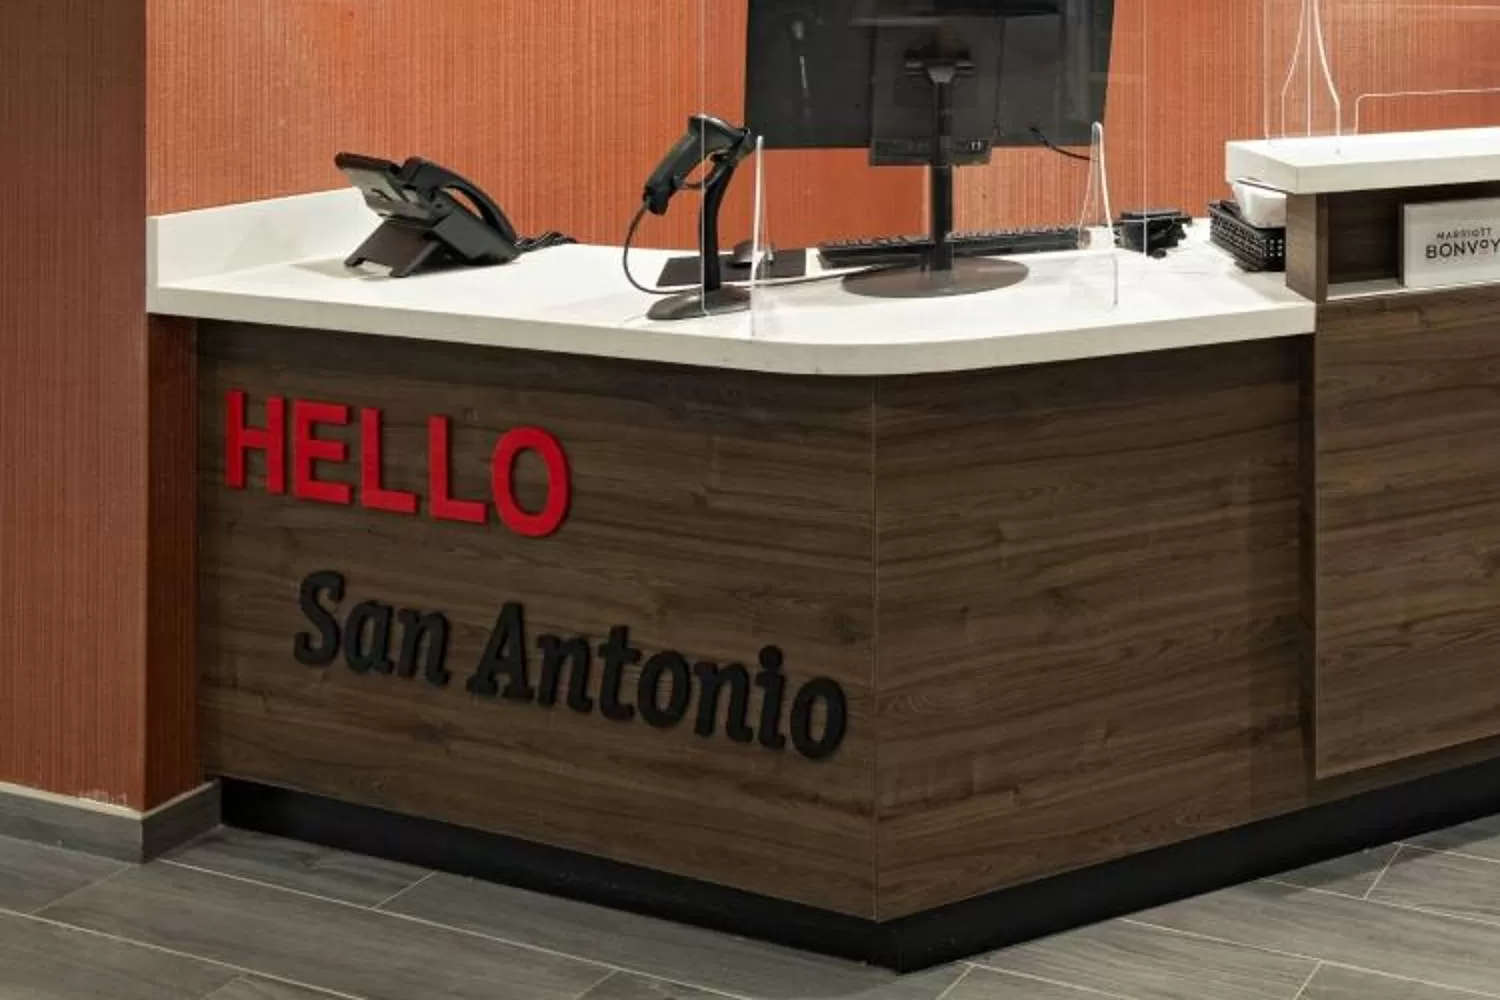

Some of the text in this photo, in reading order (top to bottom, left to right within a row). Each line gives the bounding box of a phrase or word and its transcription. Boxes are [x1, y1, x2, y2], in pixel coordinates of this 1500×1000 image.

[1436, 227, 1492, 240] MARRIOTT
[224, 389, 571, 537] HELLO
[293, 571, 848, 760] San Antonio
